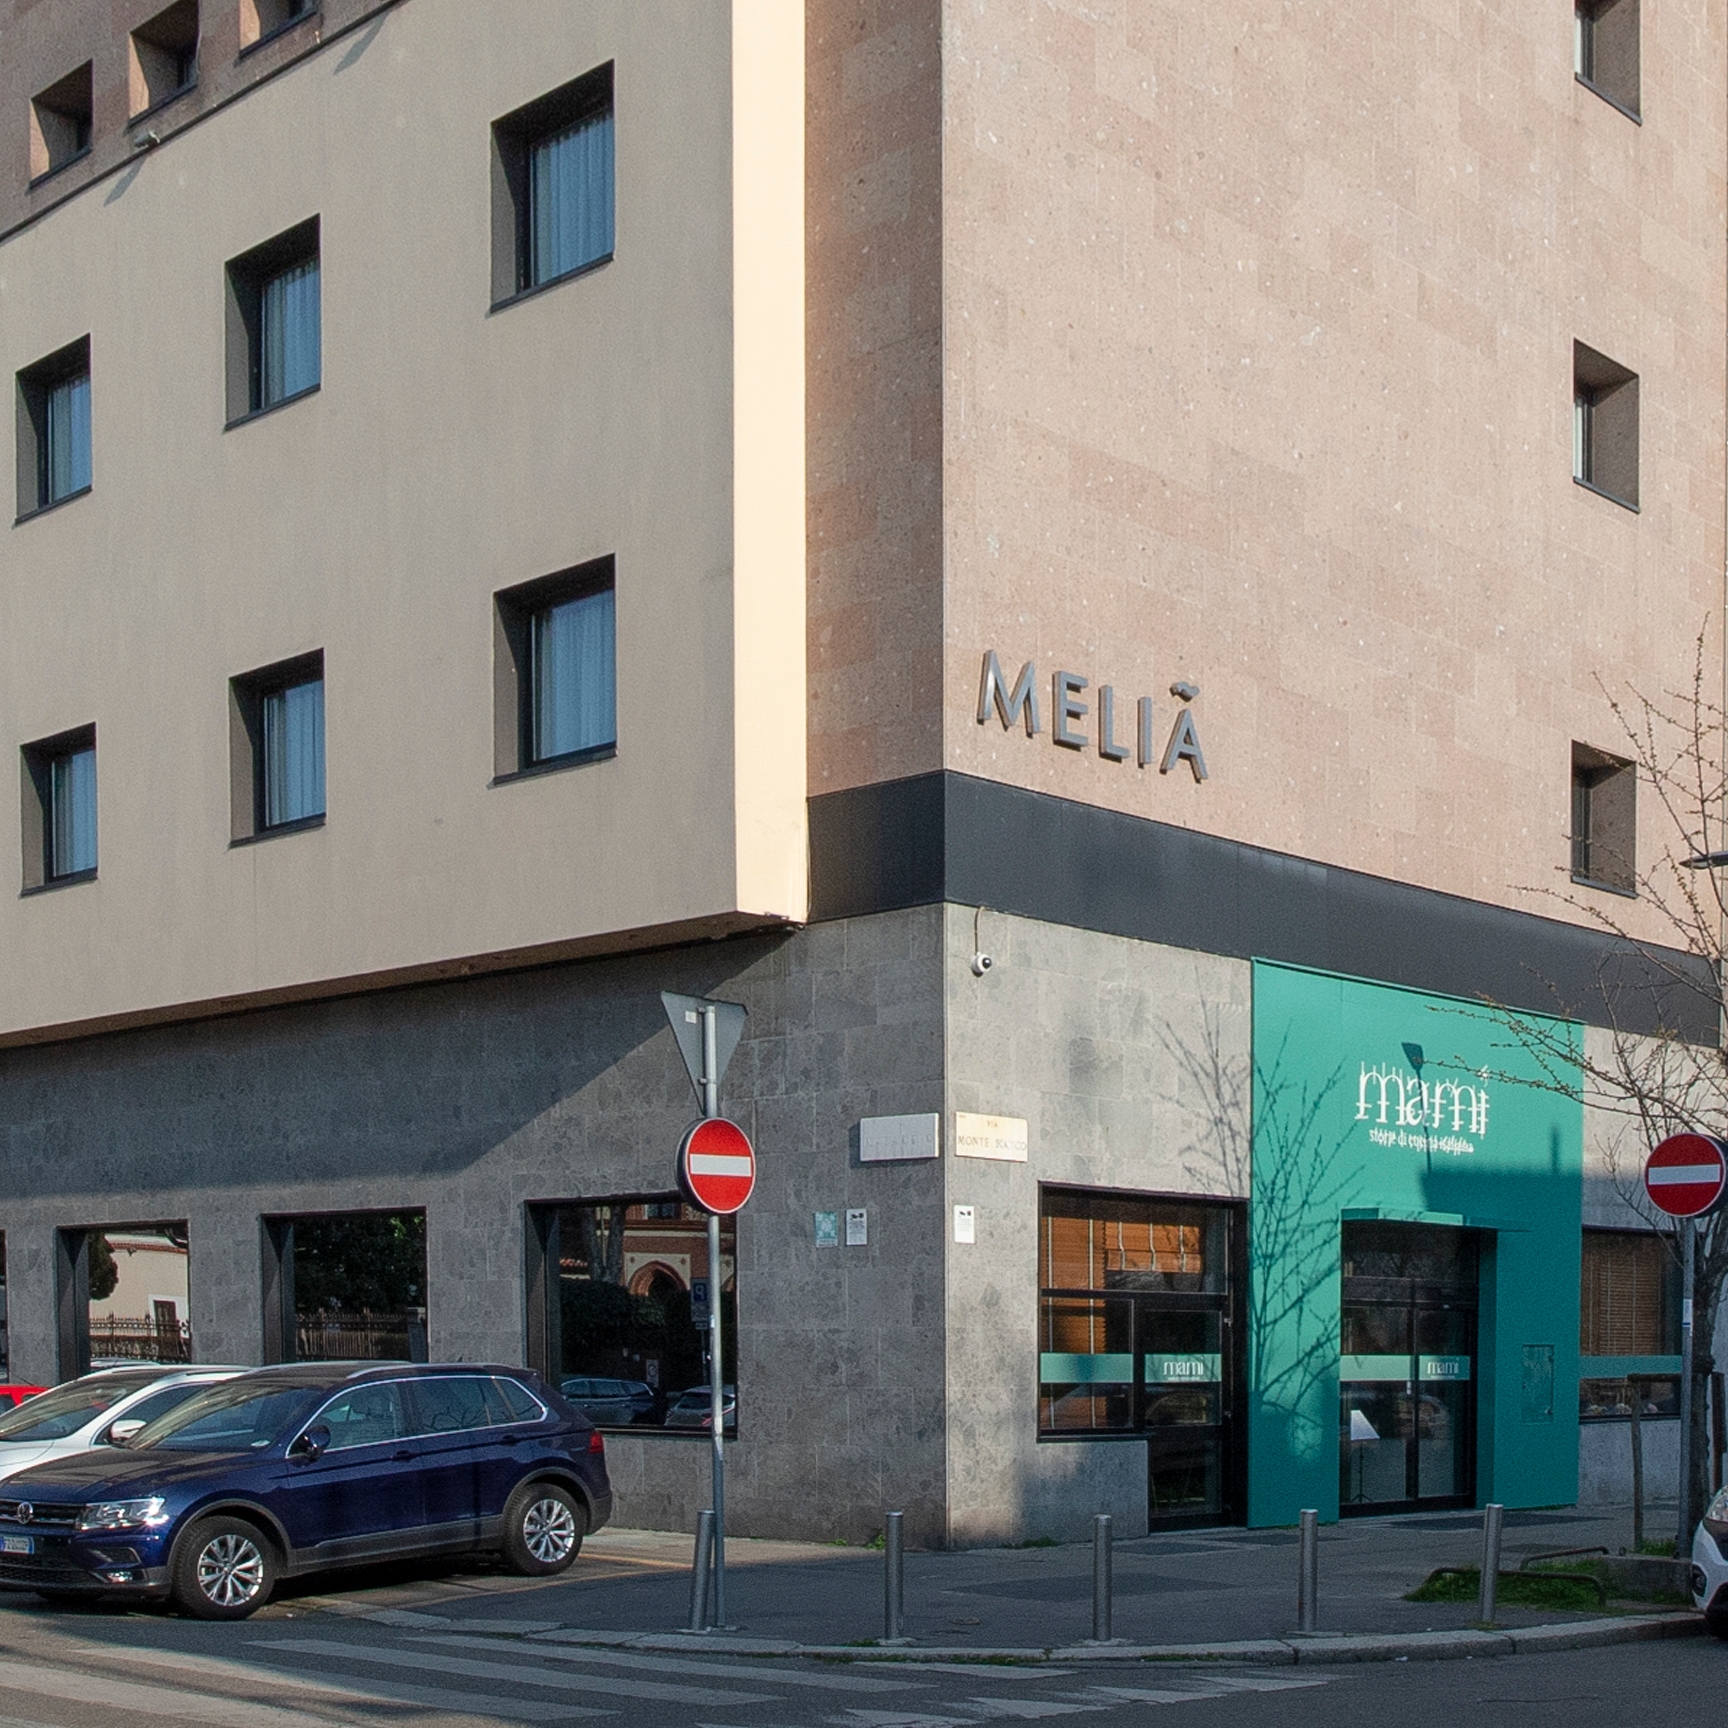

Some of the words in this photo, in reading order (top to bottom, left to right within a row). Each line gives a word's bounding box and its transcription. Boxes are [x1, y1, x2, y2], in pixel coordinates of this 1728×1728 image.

[1354, 1061, 1490, 1139] mami
[958, 1135, 990, 1148] MONTE
[1163, 1356, 1204, 1375] mami
